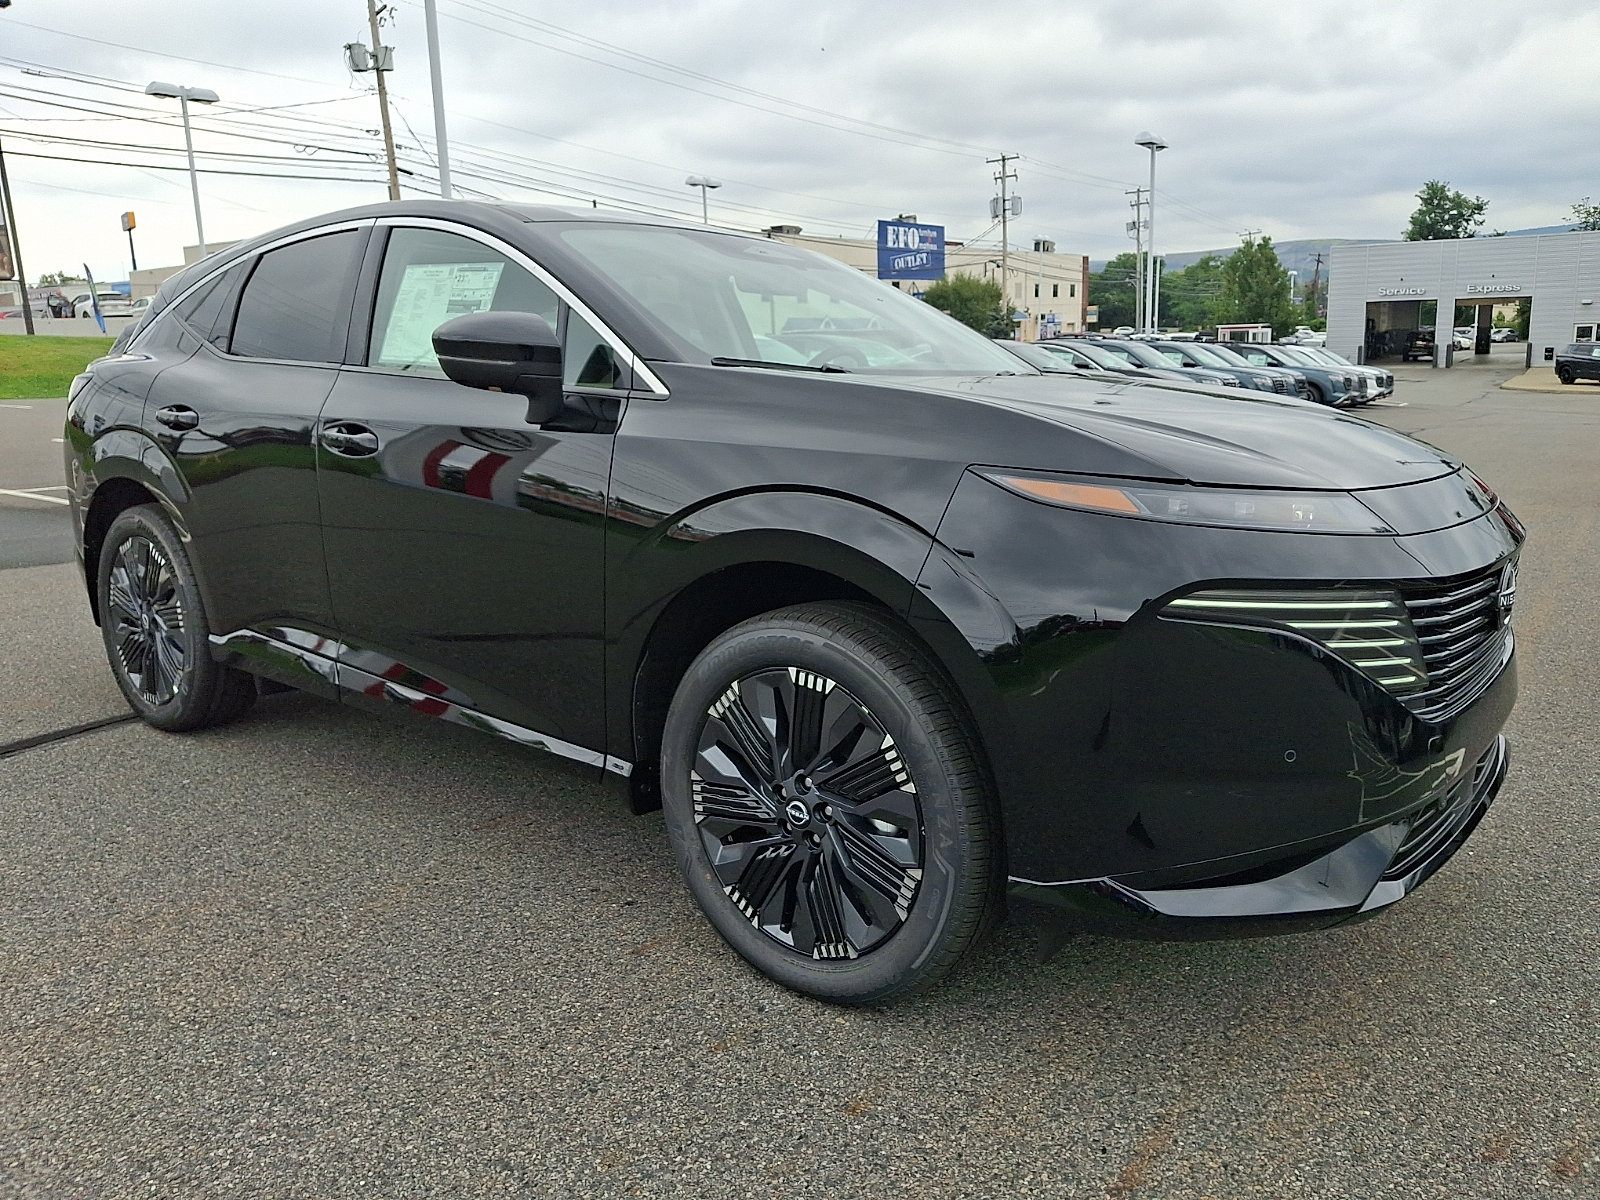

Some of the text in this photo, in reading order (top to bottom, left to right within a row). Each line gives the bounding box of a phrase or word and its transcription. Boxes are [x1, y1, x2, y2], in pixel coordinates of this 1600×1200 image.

[886, 226, 919, 250] EFO
[894, 252, 927, 270] OUTLET
[1378, 284, 1521, 297] Service Express
